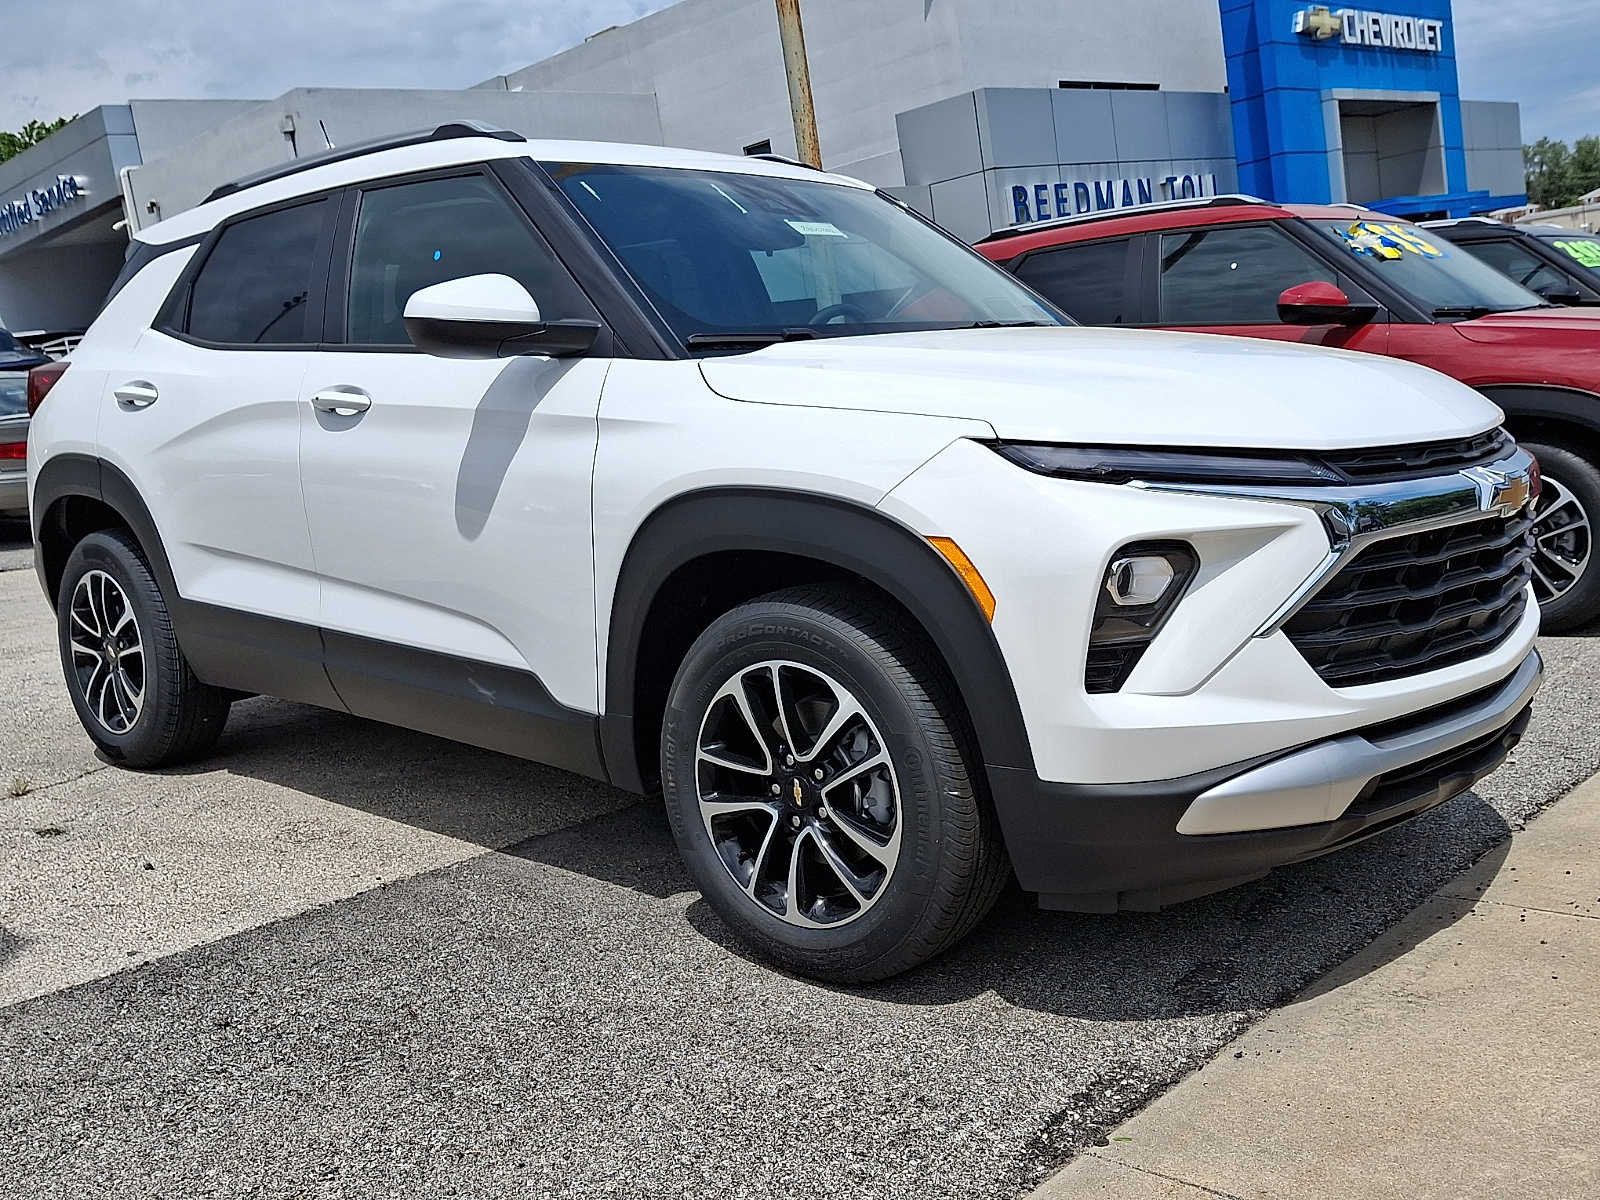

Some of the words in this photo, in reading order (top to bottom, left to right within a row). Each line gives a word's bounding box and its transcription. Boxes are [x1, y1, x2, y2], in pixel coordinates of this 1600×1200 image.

[1339, 8, 1443, 52] CHEVROLET
[32, 173, 79, 216] Service
[1011, 178, 1153, 223] REEDMAN
